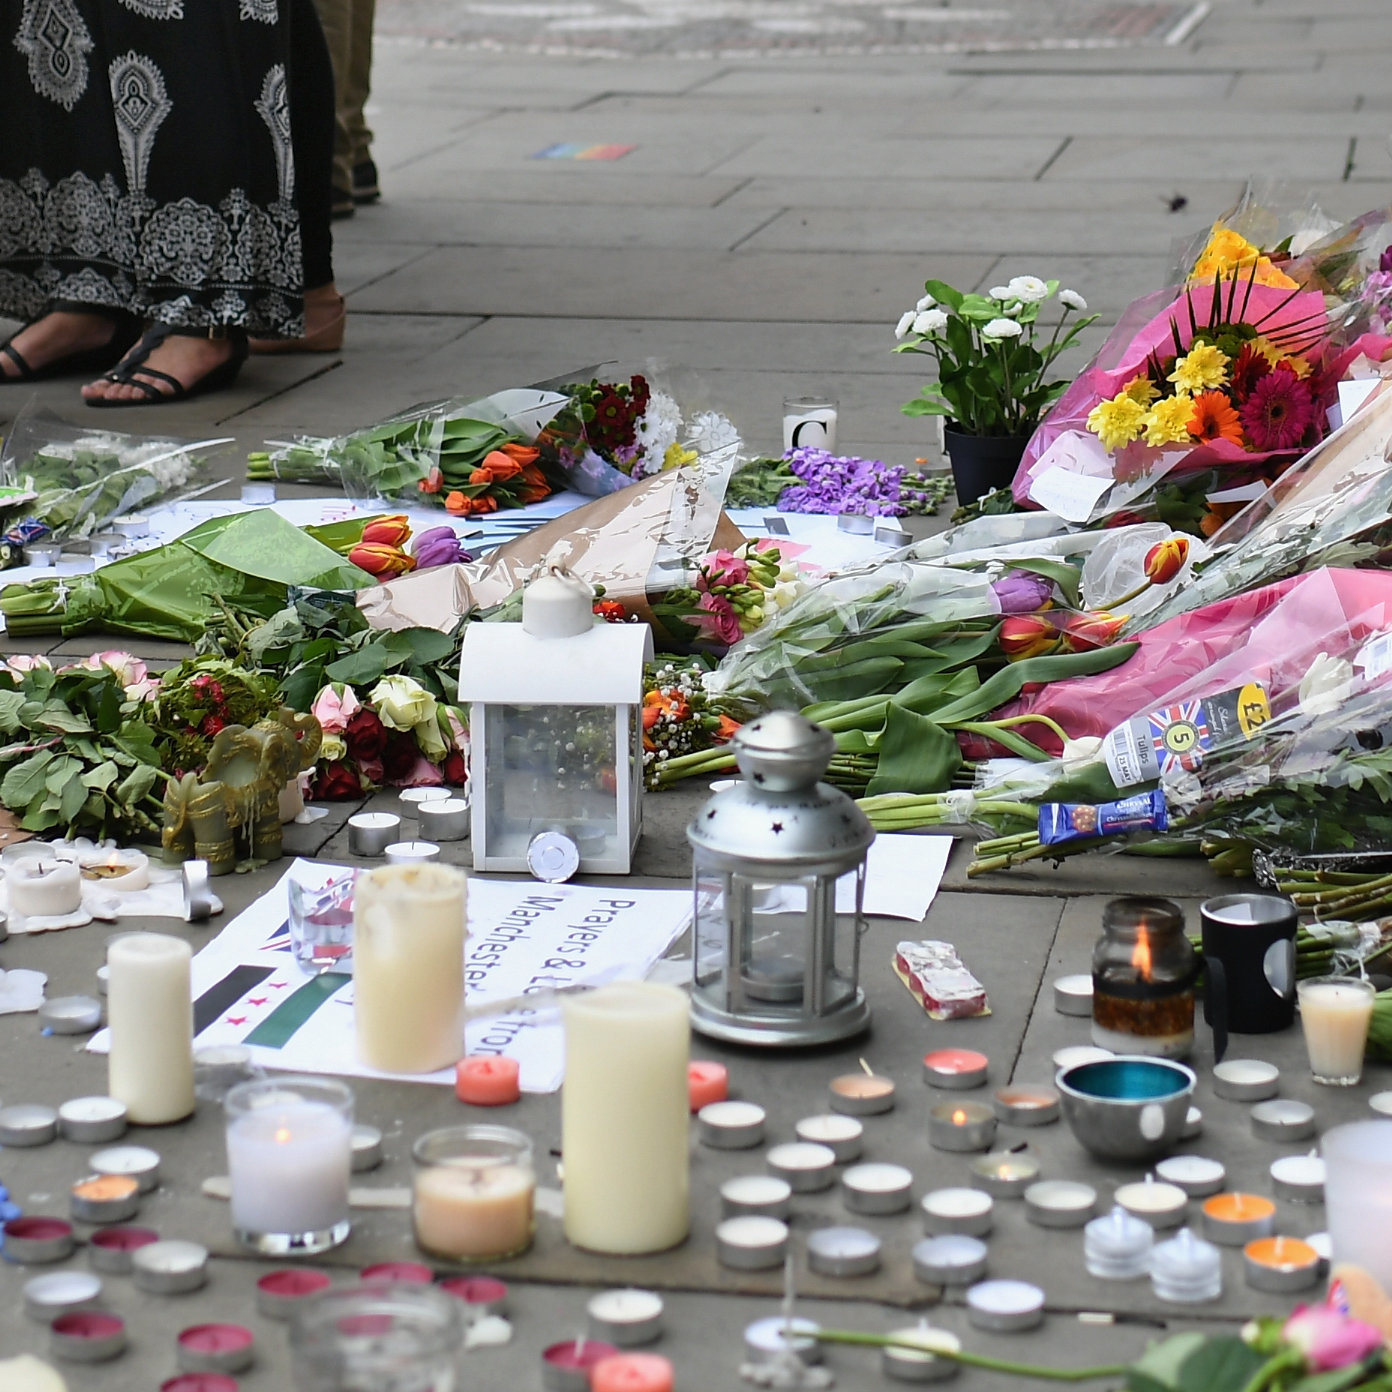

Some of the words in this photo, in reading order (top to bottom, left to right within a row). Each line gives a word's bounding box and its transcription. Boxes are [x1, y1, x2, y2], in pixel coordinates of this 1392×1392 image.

[1243, 702, 1267, 731] £2
[1137, 734, 1149, 765] Tulips
[1173, 732, 1190, 744] 5
[557, 898, 637, 954] Prayers
[540, 957, 586, 970] &
[470, 1020, 536, 1057] fro
